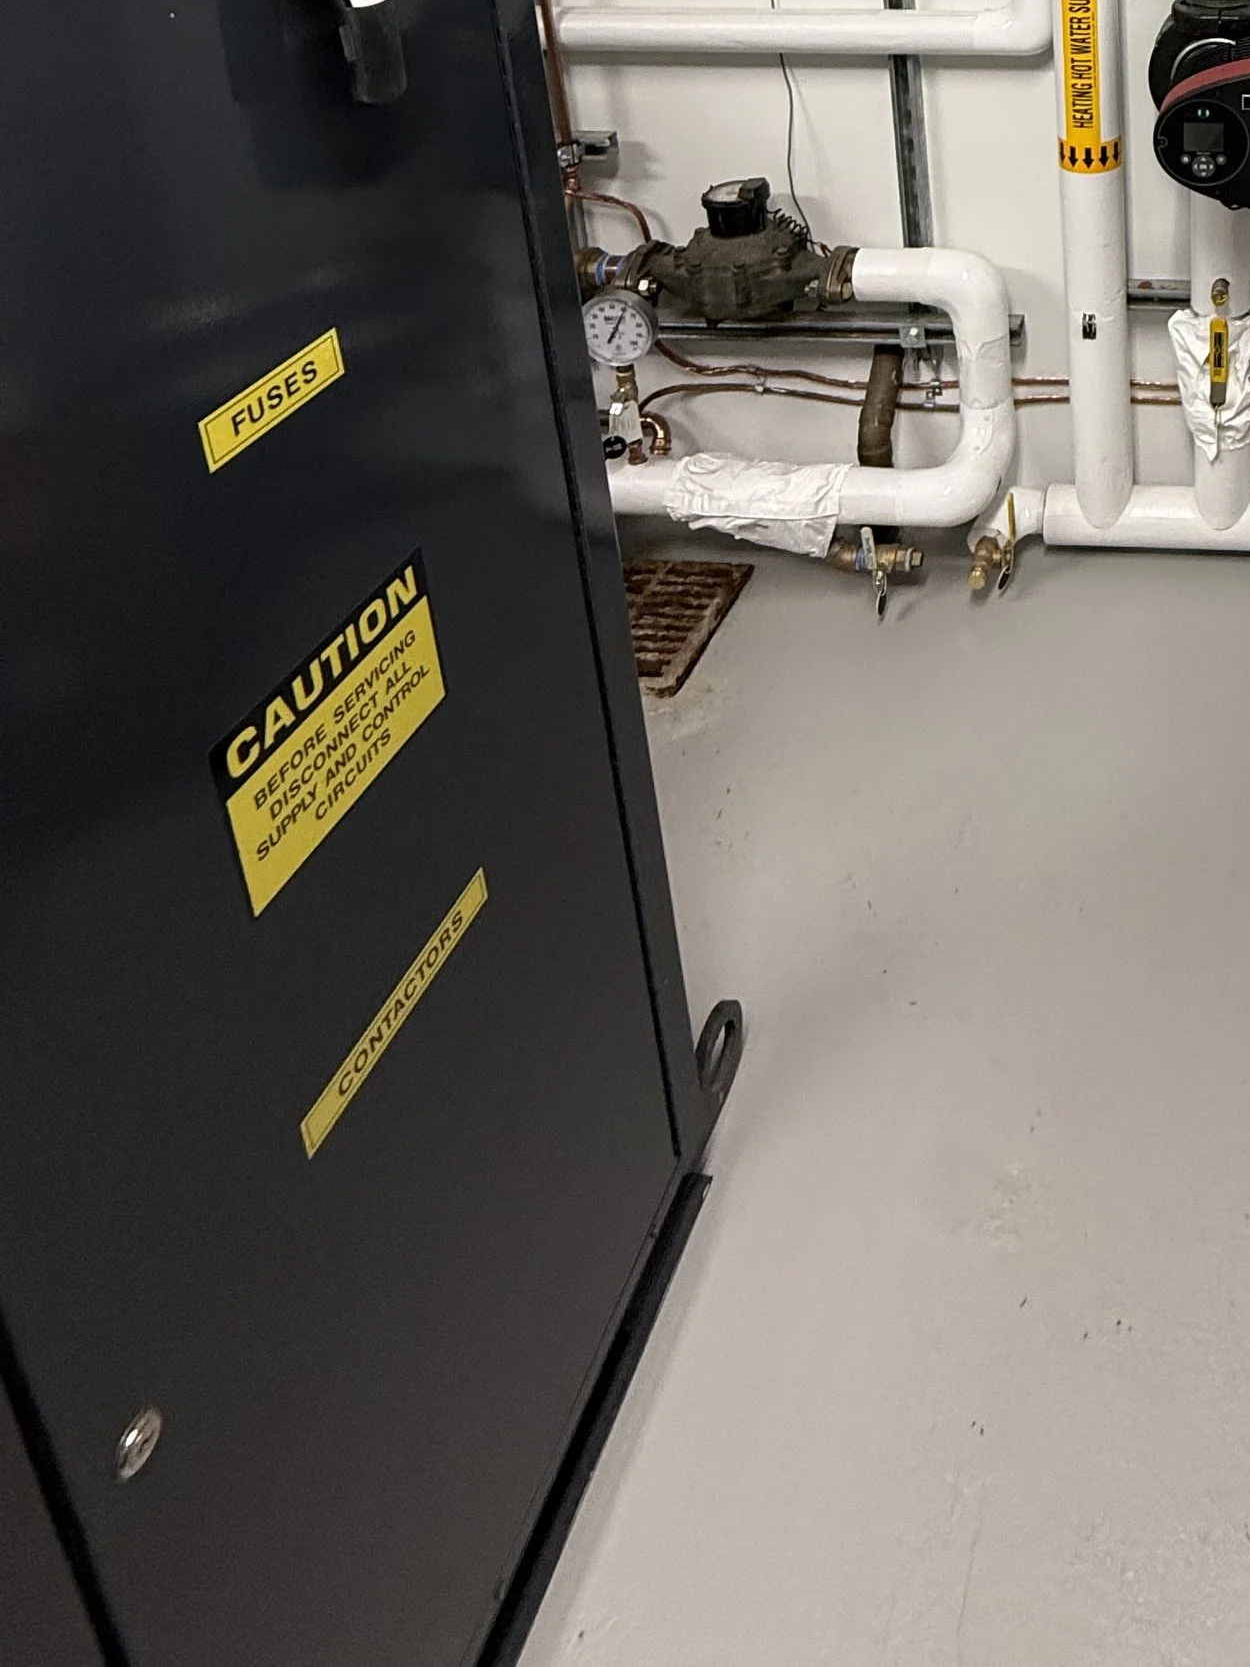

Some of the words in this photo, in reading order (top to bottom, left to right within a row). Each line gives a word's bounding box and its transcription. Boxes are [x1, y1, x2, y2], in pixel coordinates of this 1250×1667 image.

[1069, 16, 1092, 55] WATER
[1071, 57, 1093, 80] HOT
[1072, 82, 1094, 129] HEATING
[230, 360, 318, 437] FUSES
[225, 564, 418, 780] CAUTION
[253, 721, 326, 811] BEFORE
[333, 628, 417, 724] SERVICING
[256, 787, 318, 861] SUPPLY
[325, 741, 357, 788] AND
[361, 664, 431, 741] CONTROL
[268, 693, 379, 821] DISCONNECT
[385, 661, 413, 695] ALL
[314, 726, 392, 821] CIRCUITS
[337, 910, 463, 1098] CONTACTORS
